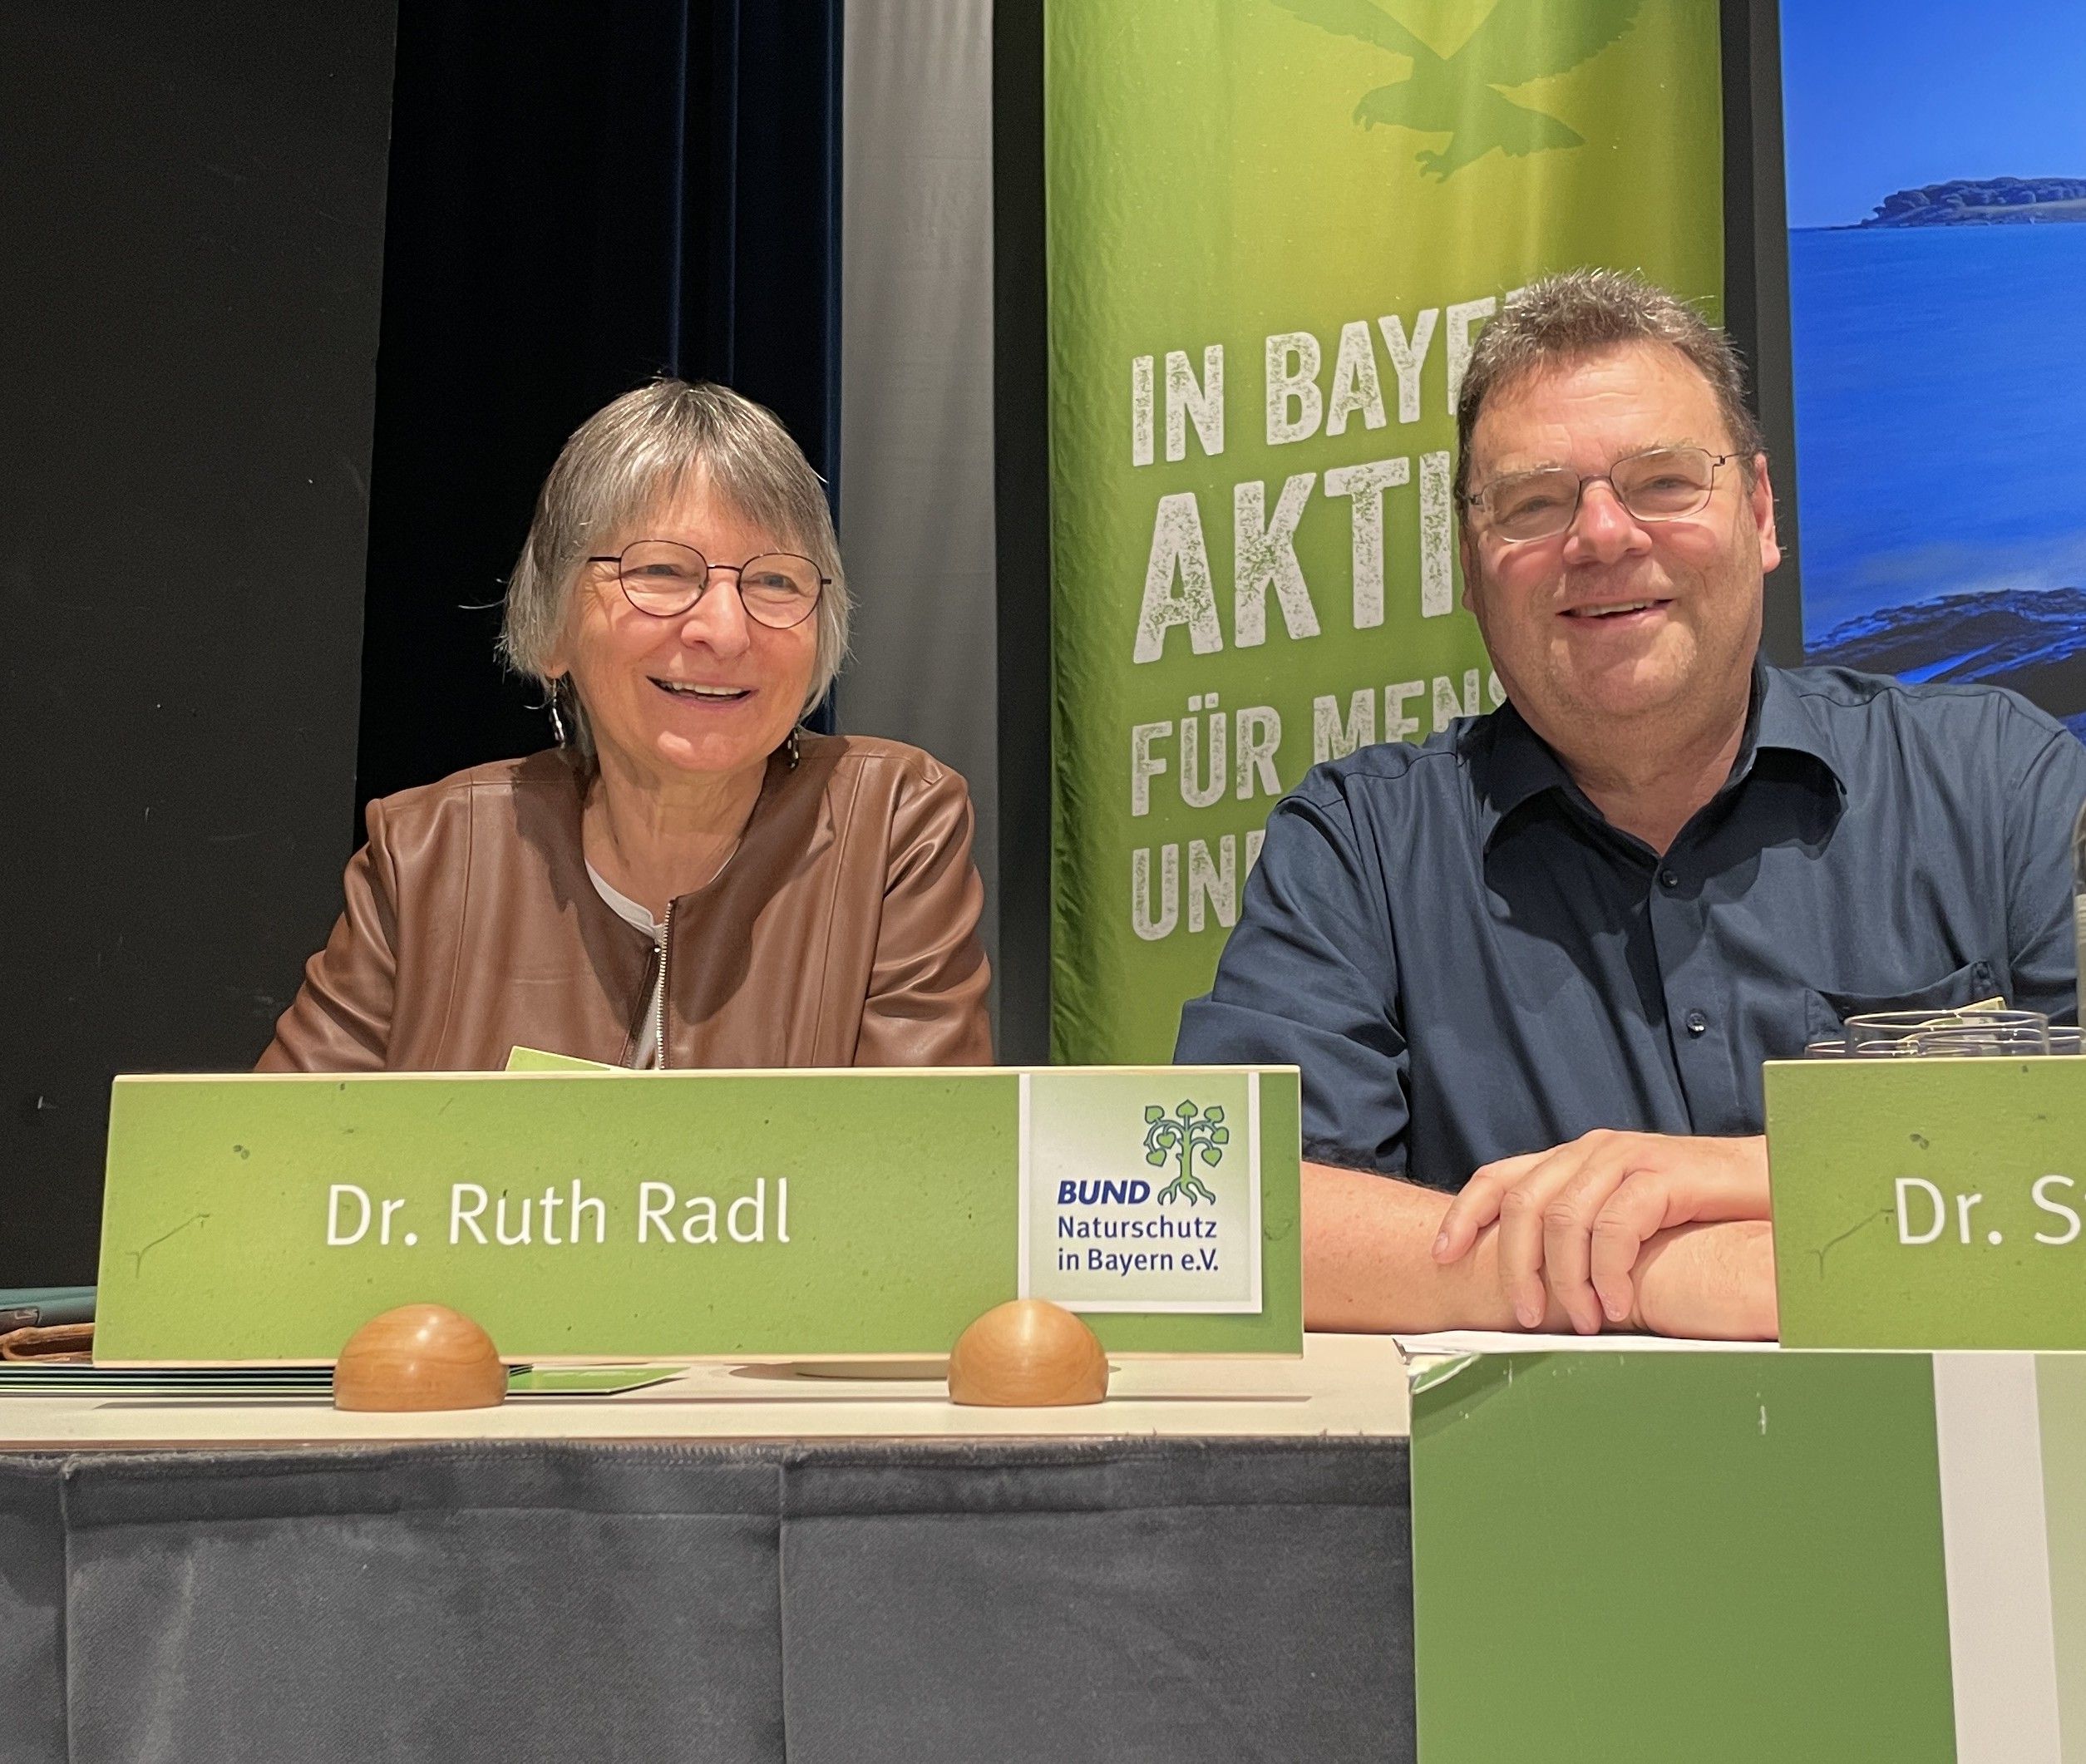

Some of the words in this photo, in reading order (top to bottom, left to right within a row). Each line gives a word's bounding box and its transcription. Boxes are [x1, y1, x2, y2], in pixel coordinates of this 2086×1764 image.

[1132, 343, 1224, 467] IN
[1265, 287, 1528, 446] BAYE
[1132, 692, 1282, 816] FÜR
[328, 1183, 418, 1245] Dr.
[450, 1179, 606, 1245] Ruth
[638, 1177, 790, 1244] Radl
[1057, 1180, 1151, 1205] BUND
[1895, 1177, 2003, 1245] Dr.
[2031, 1175, 2086, 1244] S
[1058, 1215, 1217, 1239] Naturschutz
[1058, 1247, 1079, 1270] in
[1087, 1249, 1173, 1277] Bayern
[1181, 1248, 1219, 1271] e.V.
